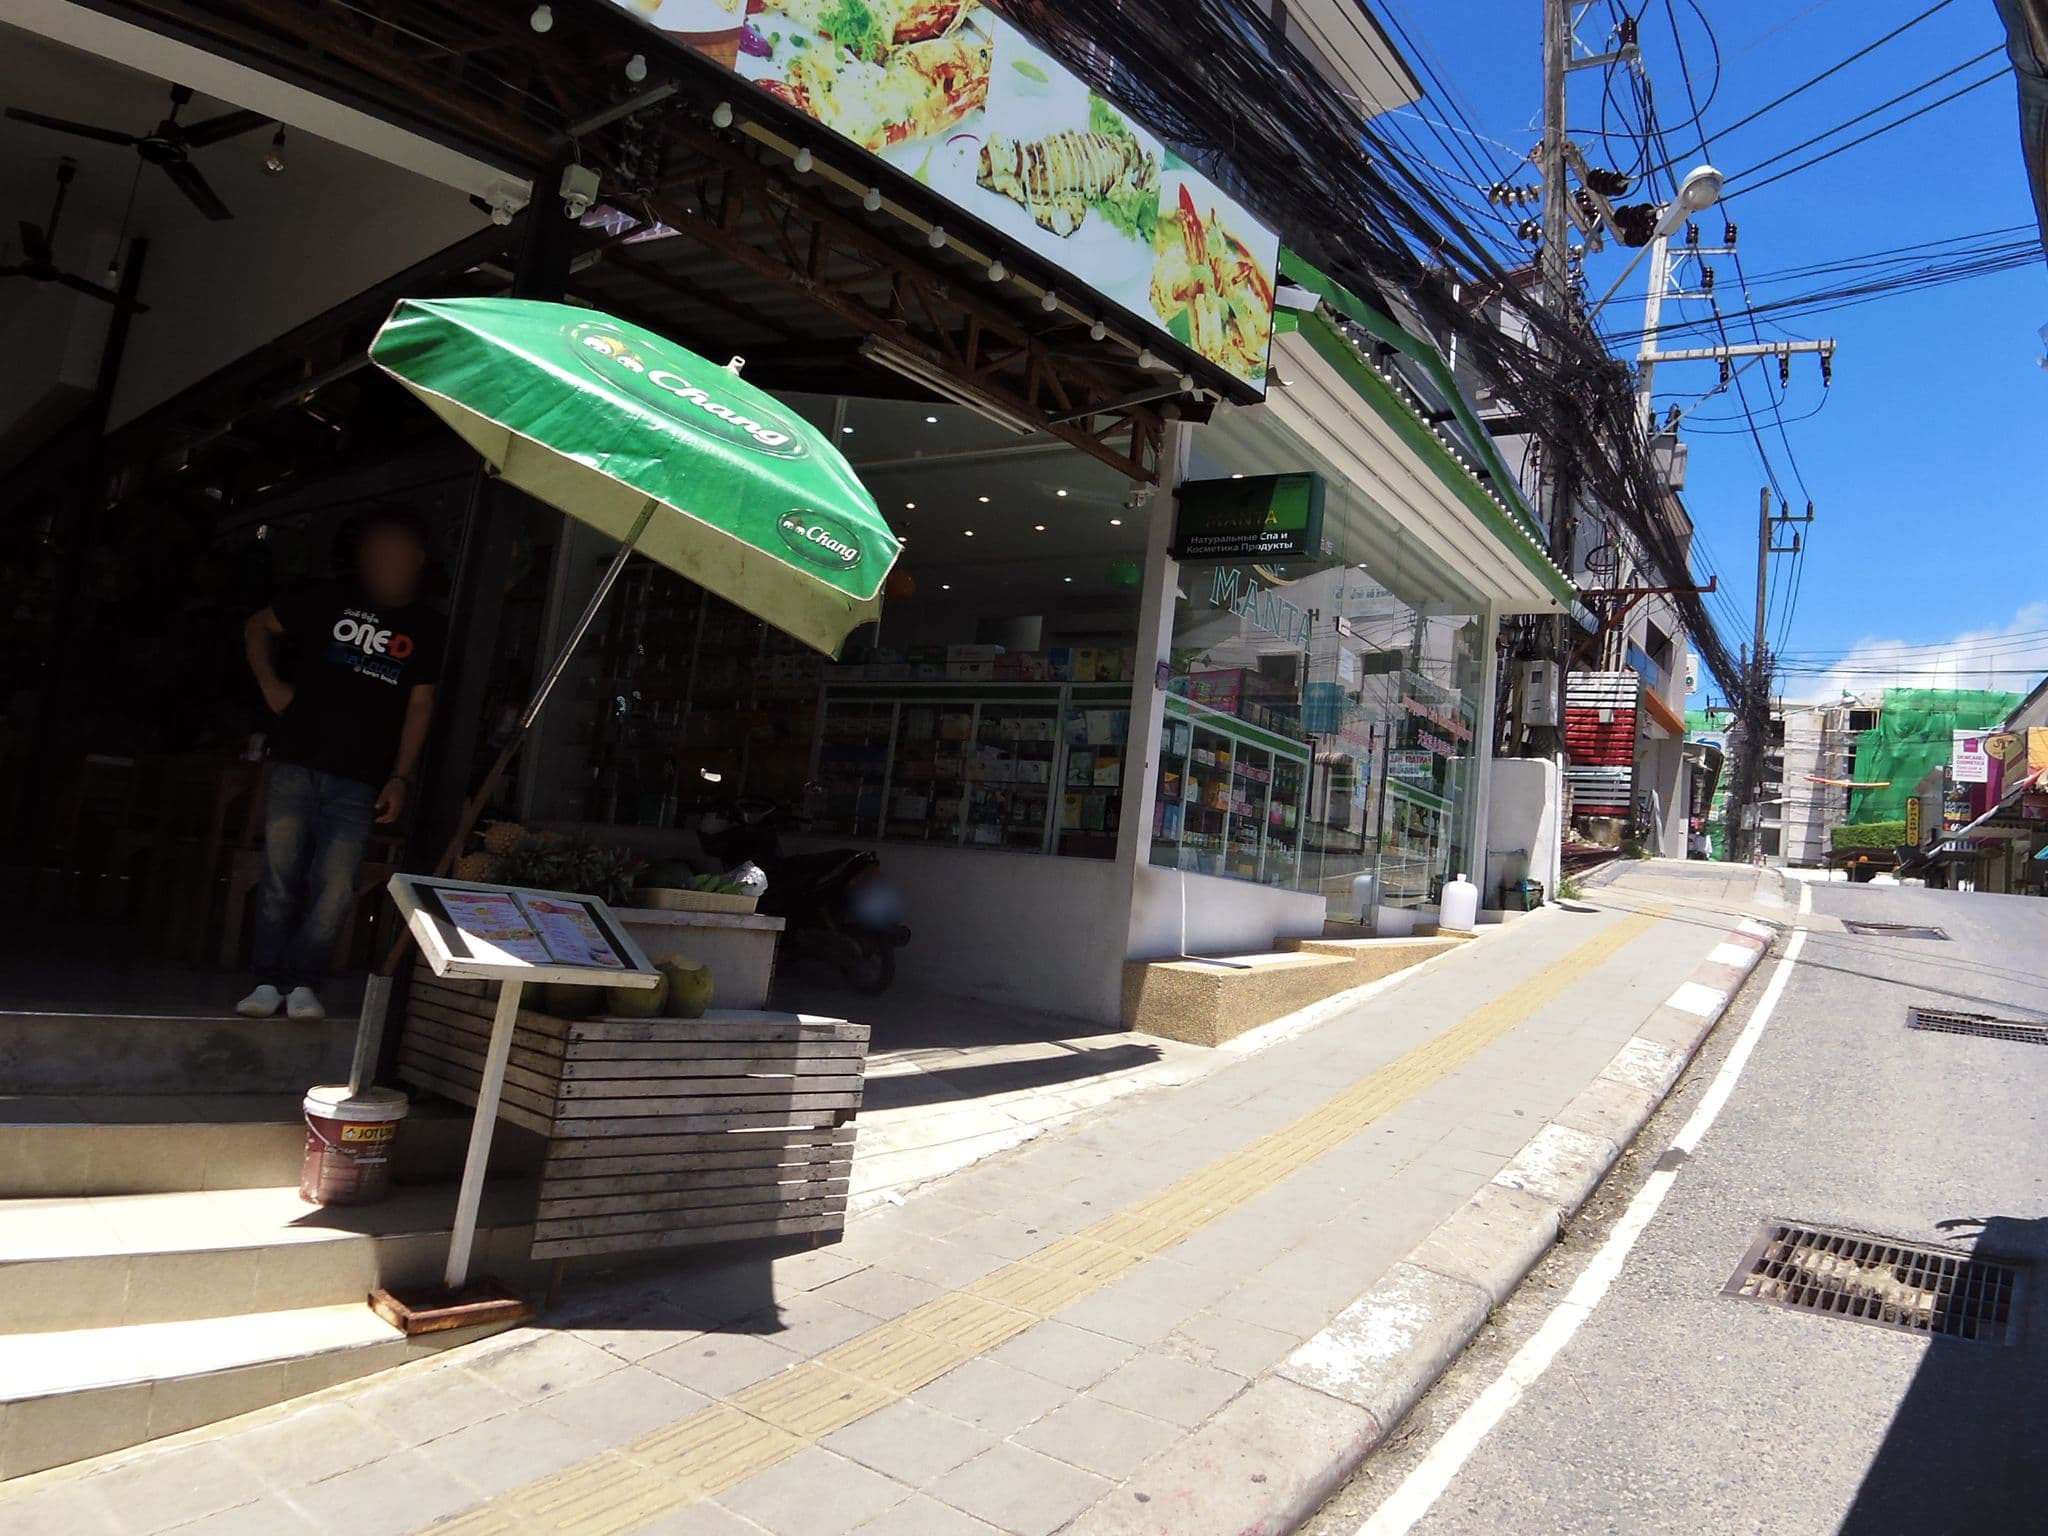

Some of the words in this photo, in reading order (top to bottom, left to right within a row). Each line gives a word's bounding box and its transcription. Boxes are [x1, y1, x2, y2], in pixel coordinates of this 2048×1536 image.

[648, 370, 790, 446] Chang
[806, 526, 858, 561] Chang
[1186, 544, 1240, 554] Косметика
[1241, 542, 1295, 553] Продукты
[1190, 534, 1258, 546] Натуральные
[1259, 532, 1279, 541] Спа
[1279, 532, 1289, 540] и
[1209, 564, 1313, 657] MANTA
